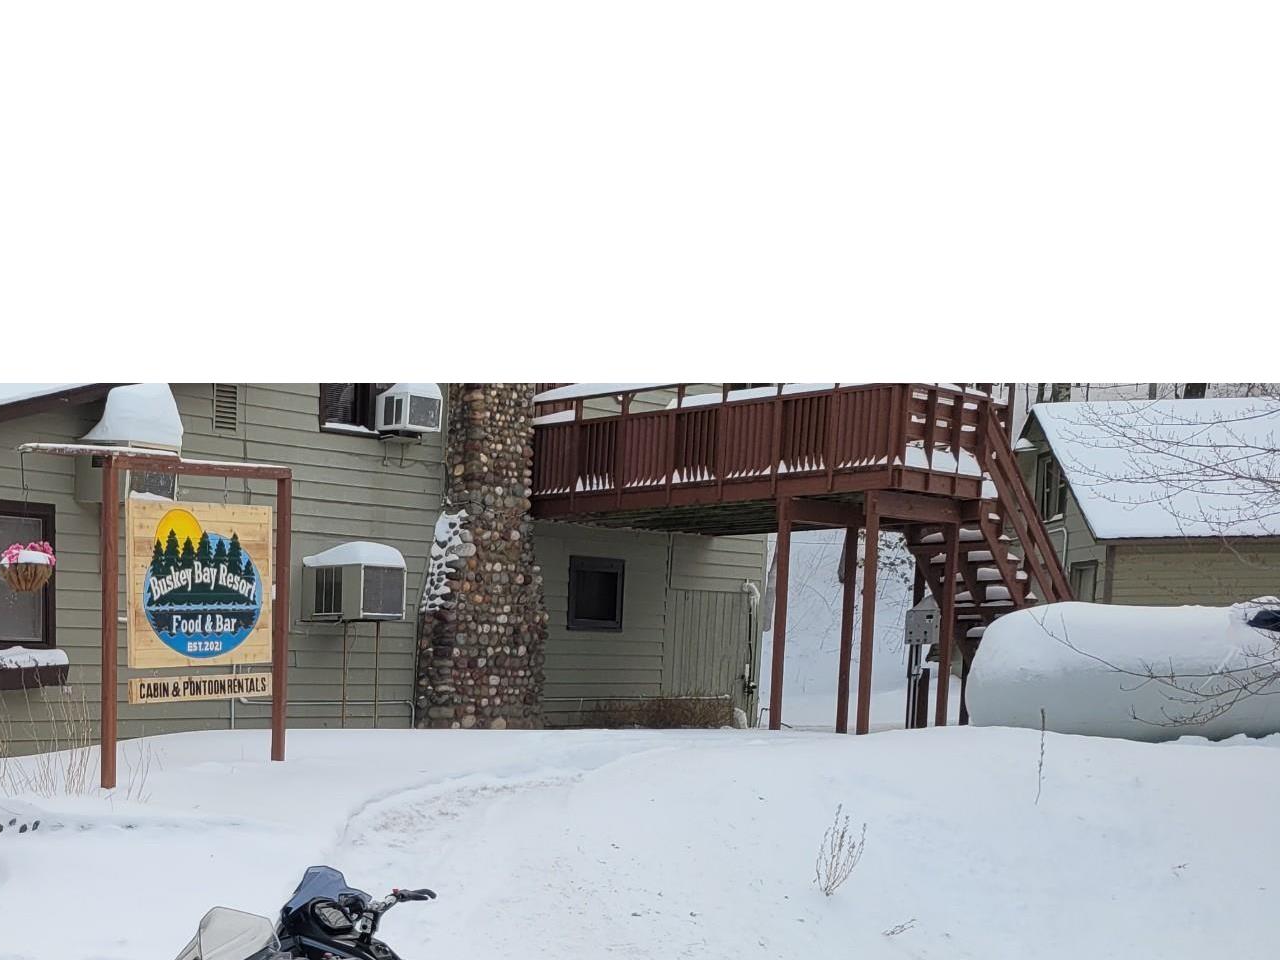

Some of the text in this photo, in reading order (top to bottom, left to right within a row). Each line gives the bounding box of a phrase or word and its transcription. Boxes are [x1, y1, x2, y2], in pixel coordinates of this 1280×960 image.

[149, 560, 256, 601] Buskey Bay Resort
[172, 614, 237, 633] Food & Bar
[139, 677, 267, 699] CABIN & PONTOON RENTALS
